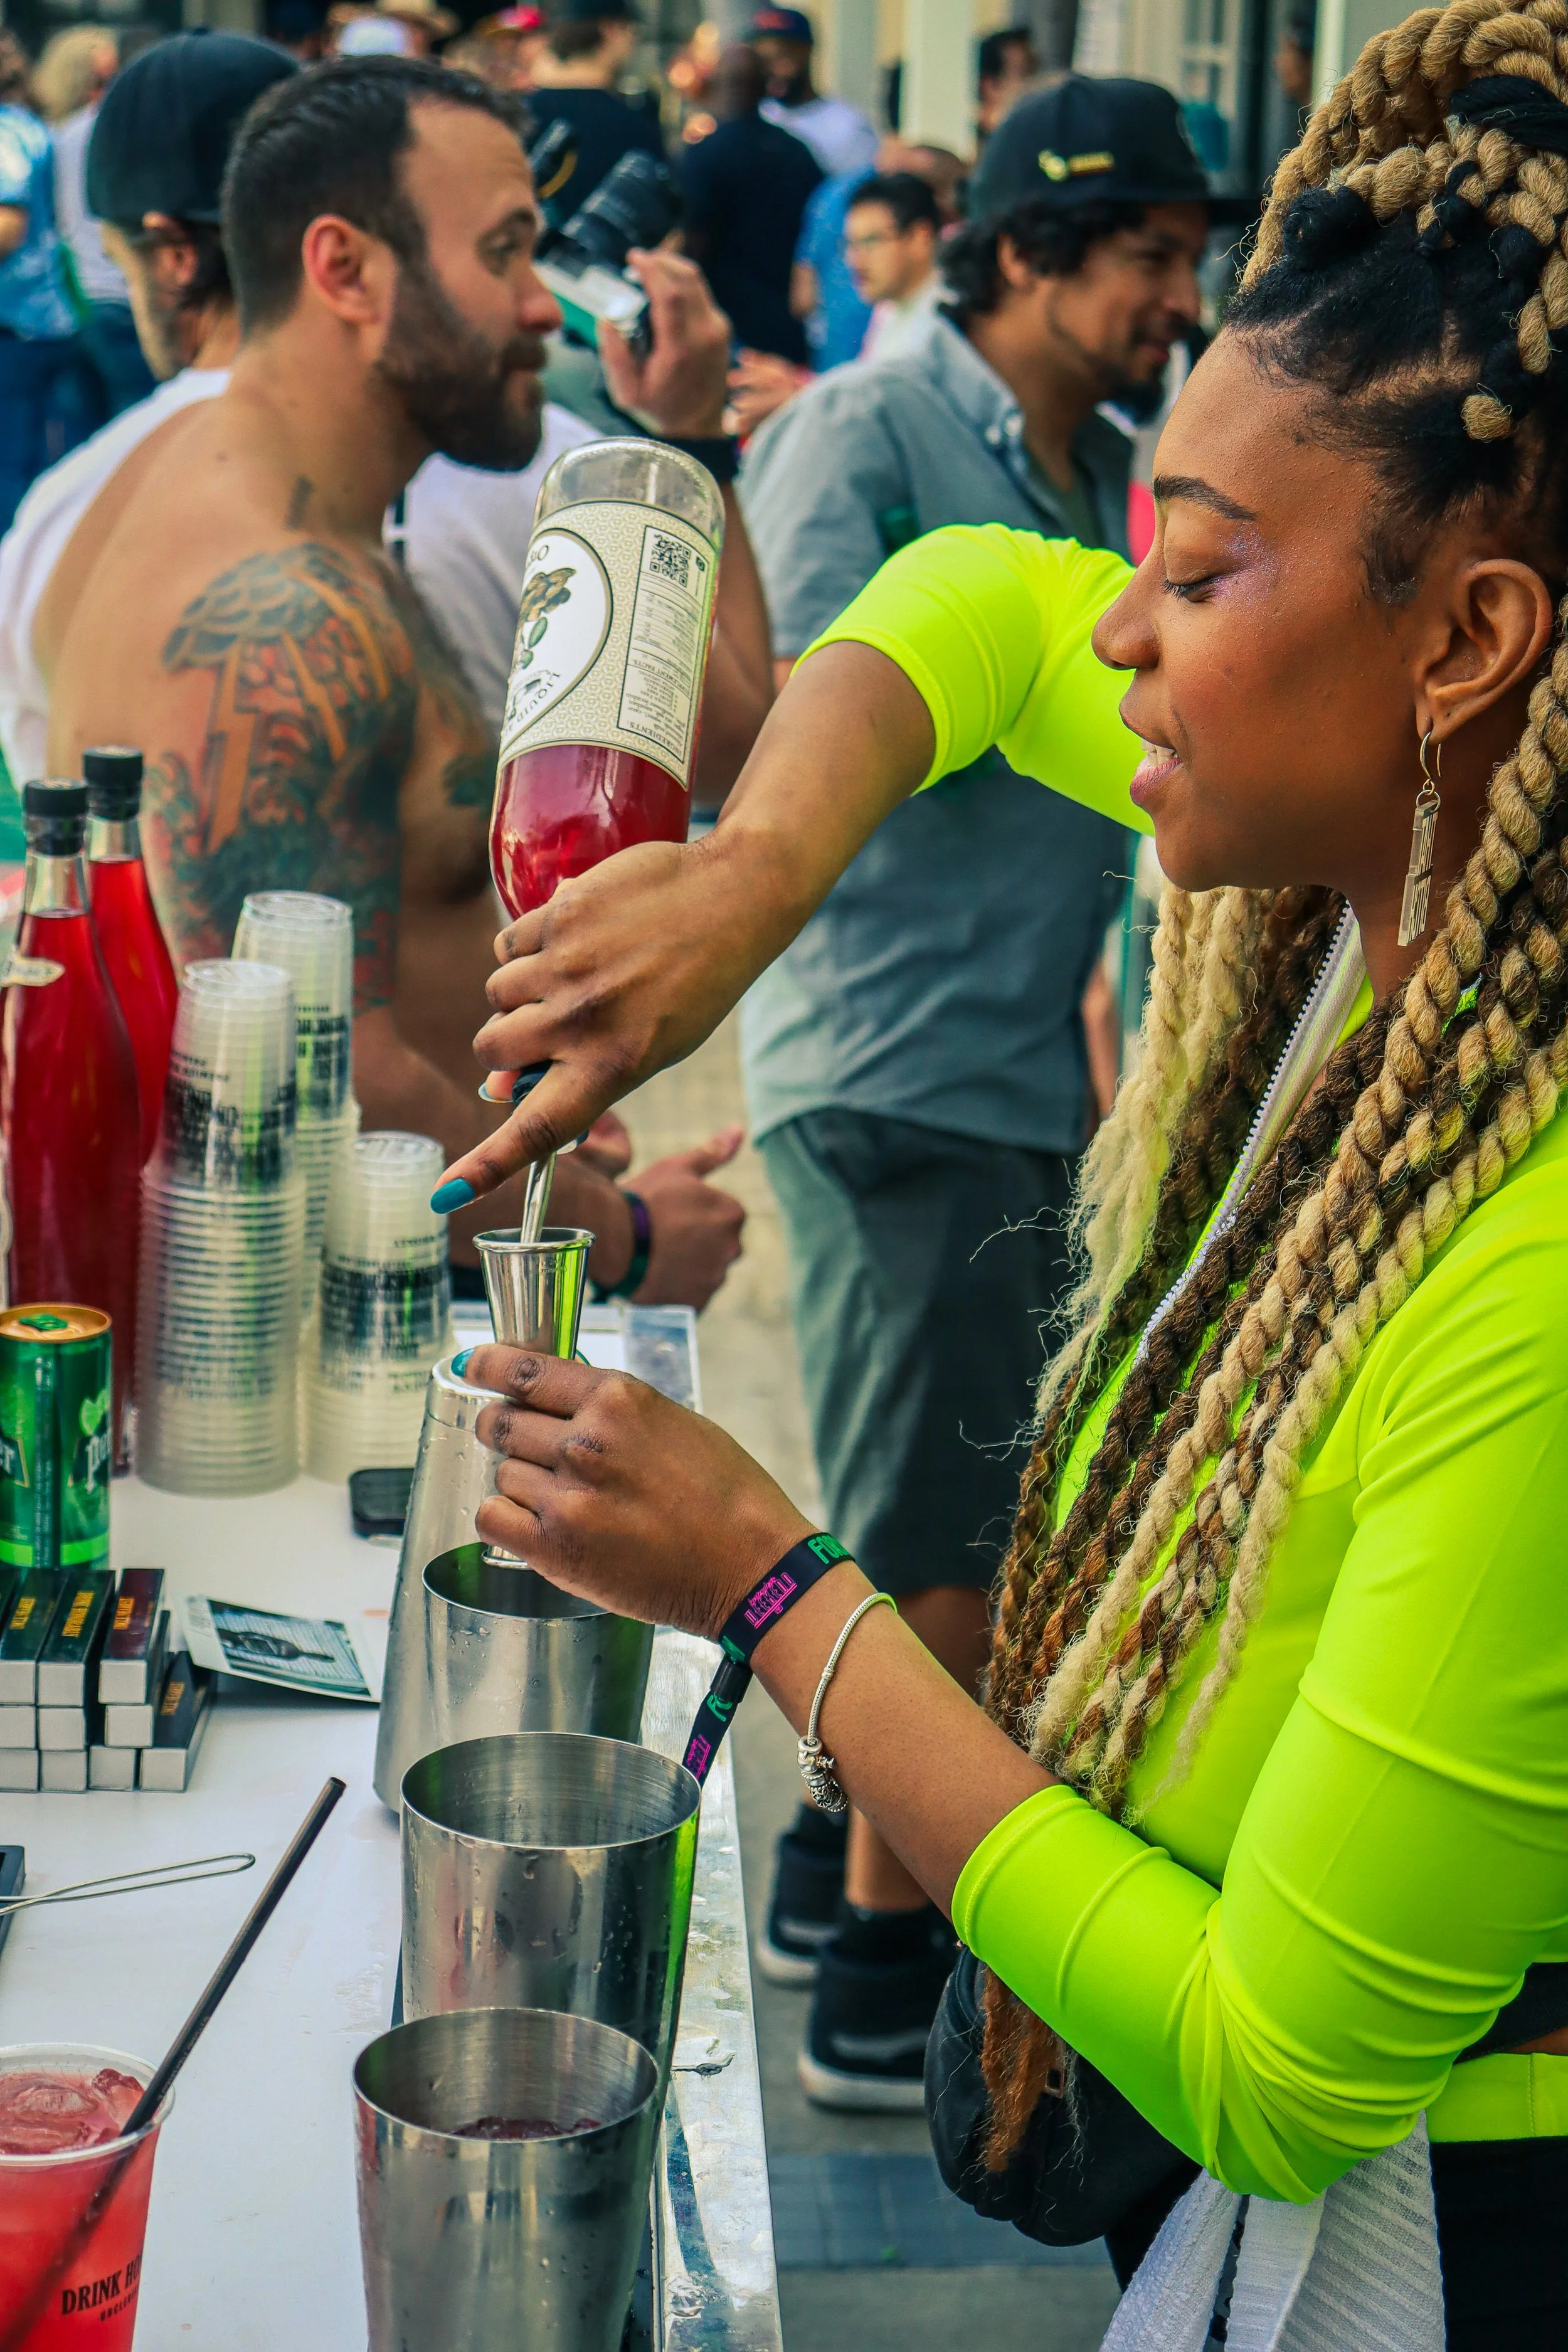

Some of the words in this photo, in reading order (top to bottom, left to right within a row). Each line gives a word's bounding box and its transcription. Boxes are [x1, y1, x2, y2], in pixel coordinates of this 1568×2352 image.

[517, 672, 560, 723] LIQUID
[744, 1572, 795, 1626] WEEKEND
[61, 2269, 122, 2316] DRINK
